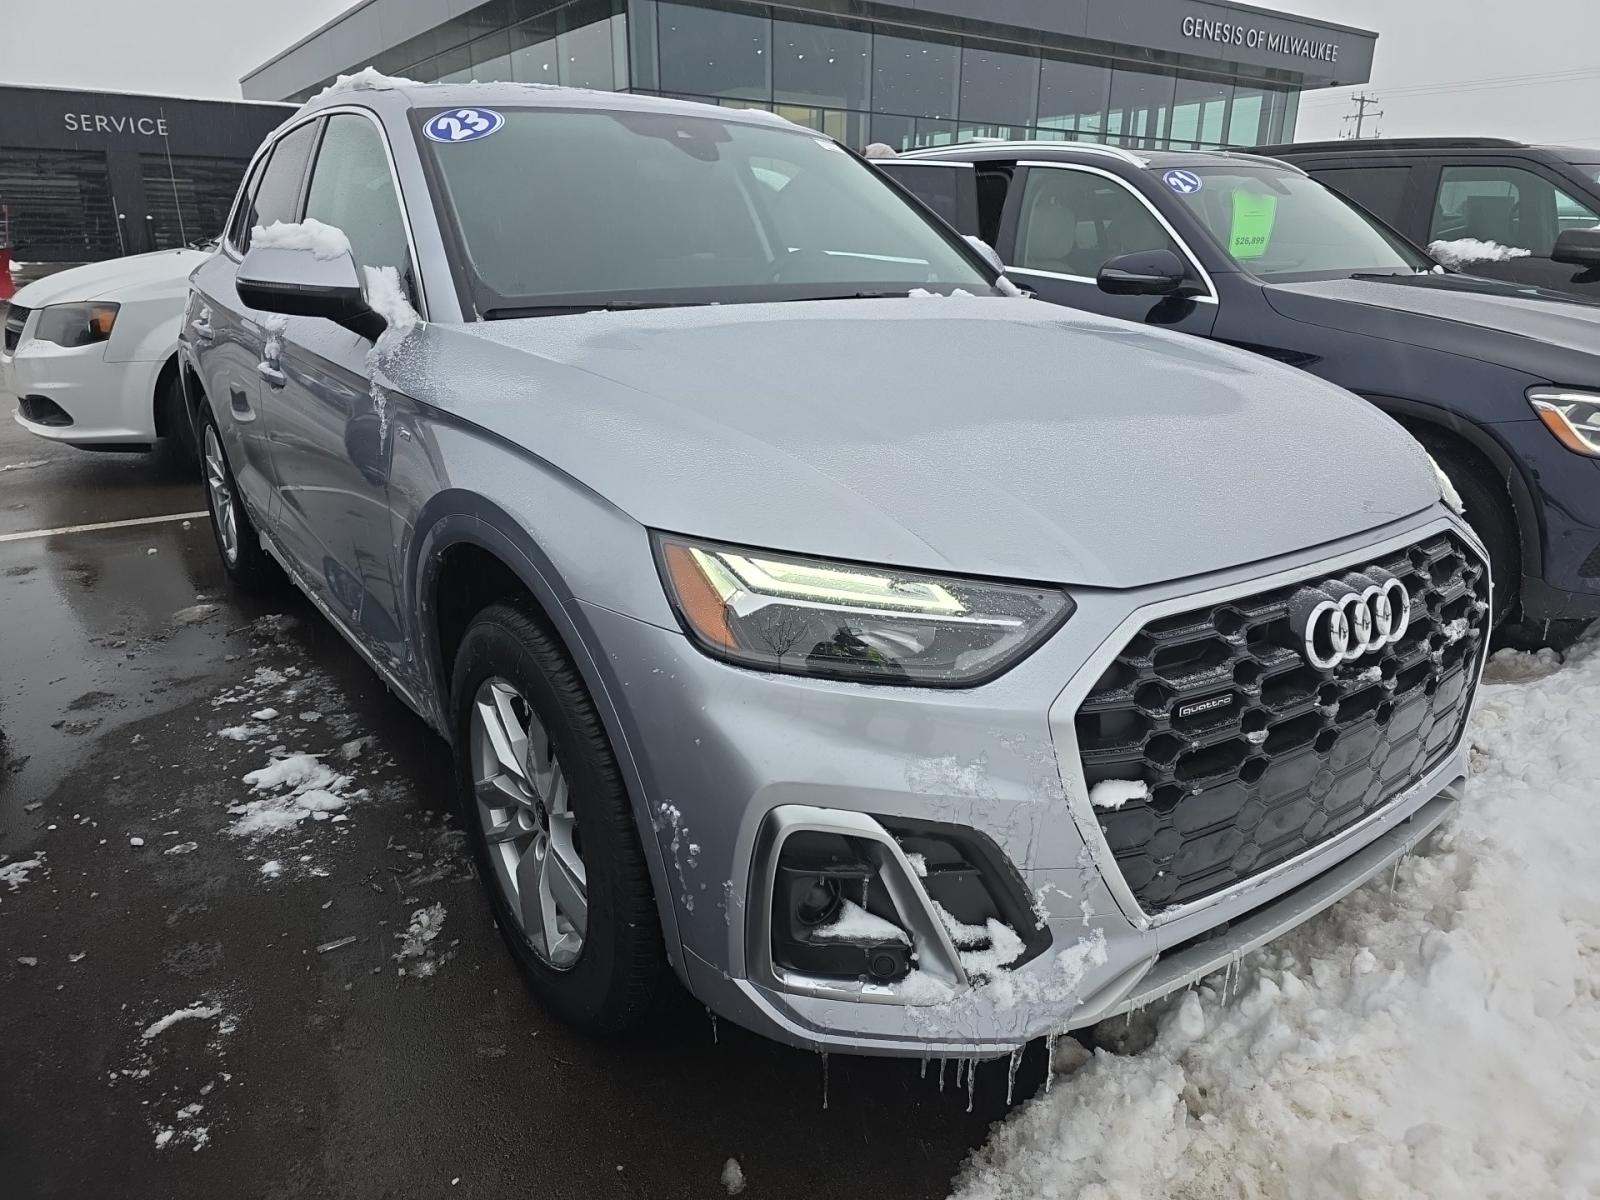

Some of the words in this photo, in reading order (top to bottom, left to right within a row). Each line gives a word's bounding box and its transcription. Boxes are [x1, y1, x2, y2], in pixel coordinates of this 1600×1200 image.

[1182, 16, 1243, 45] GENESIS
[1246, 29, 1265, 48] OF
[1267, 33, 1339, 62] MILWAUKEE
[64, 113, 169, 136] SERVICE
[437, 109, 490, 140] 23
[1168, 171, 1198, 193] 21
[1234, 236, 1265, 247] $26,899
[1182, 697, 1231, 715] quattro
